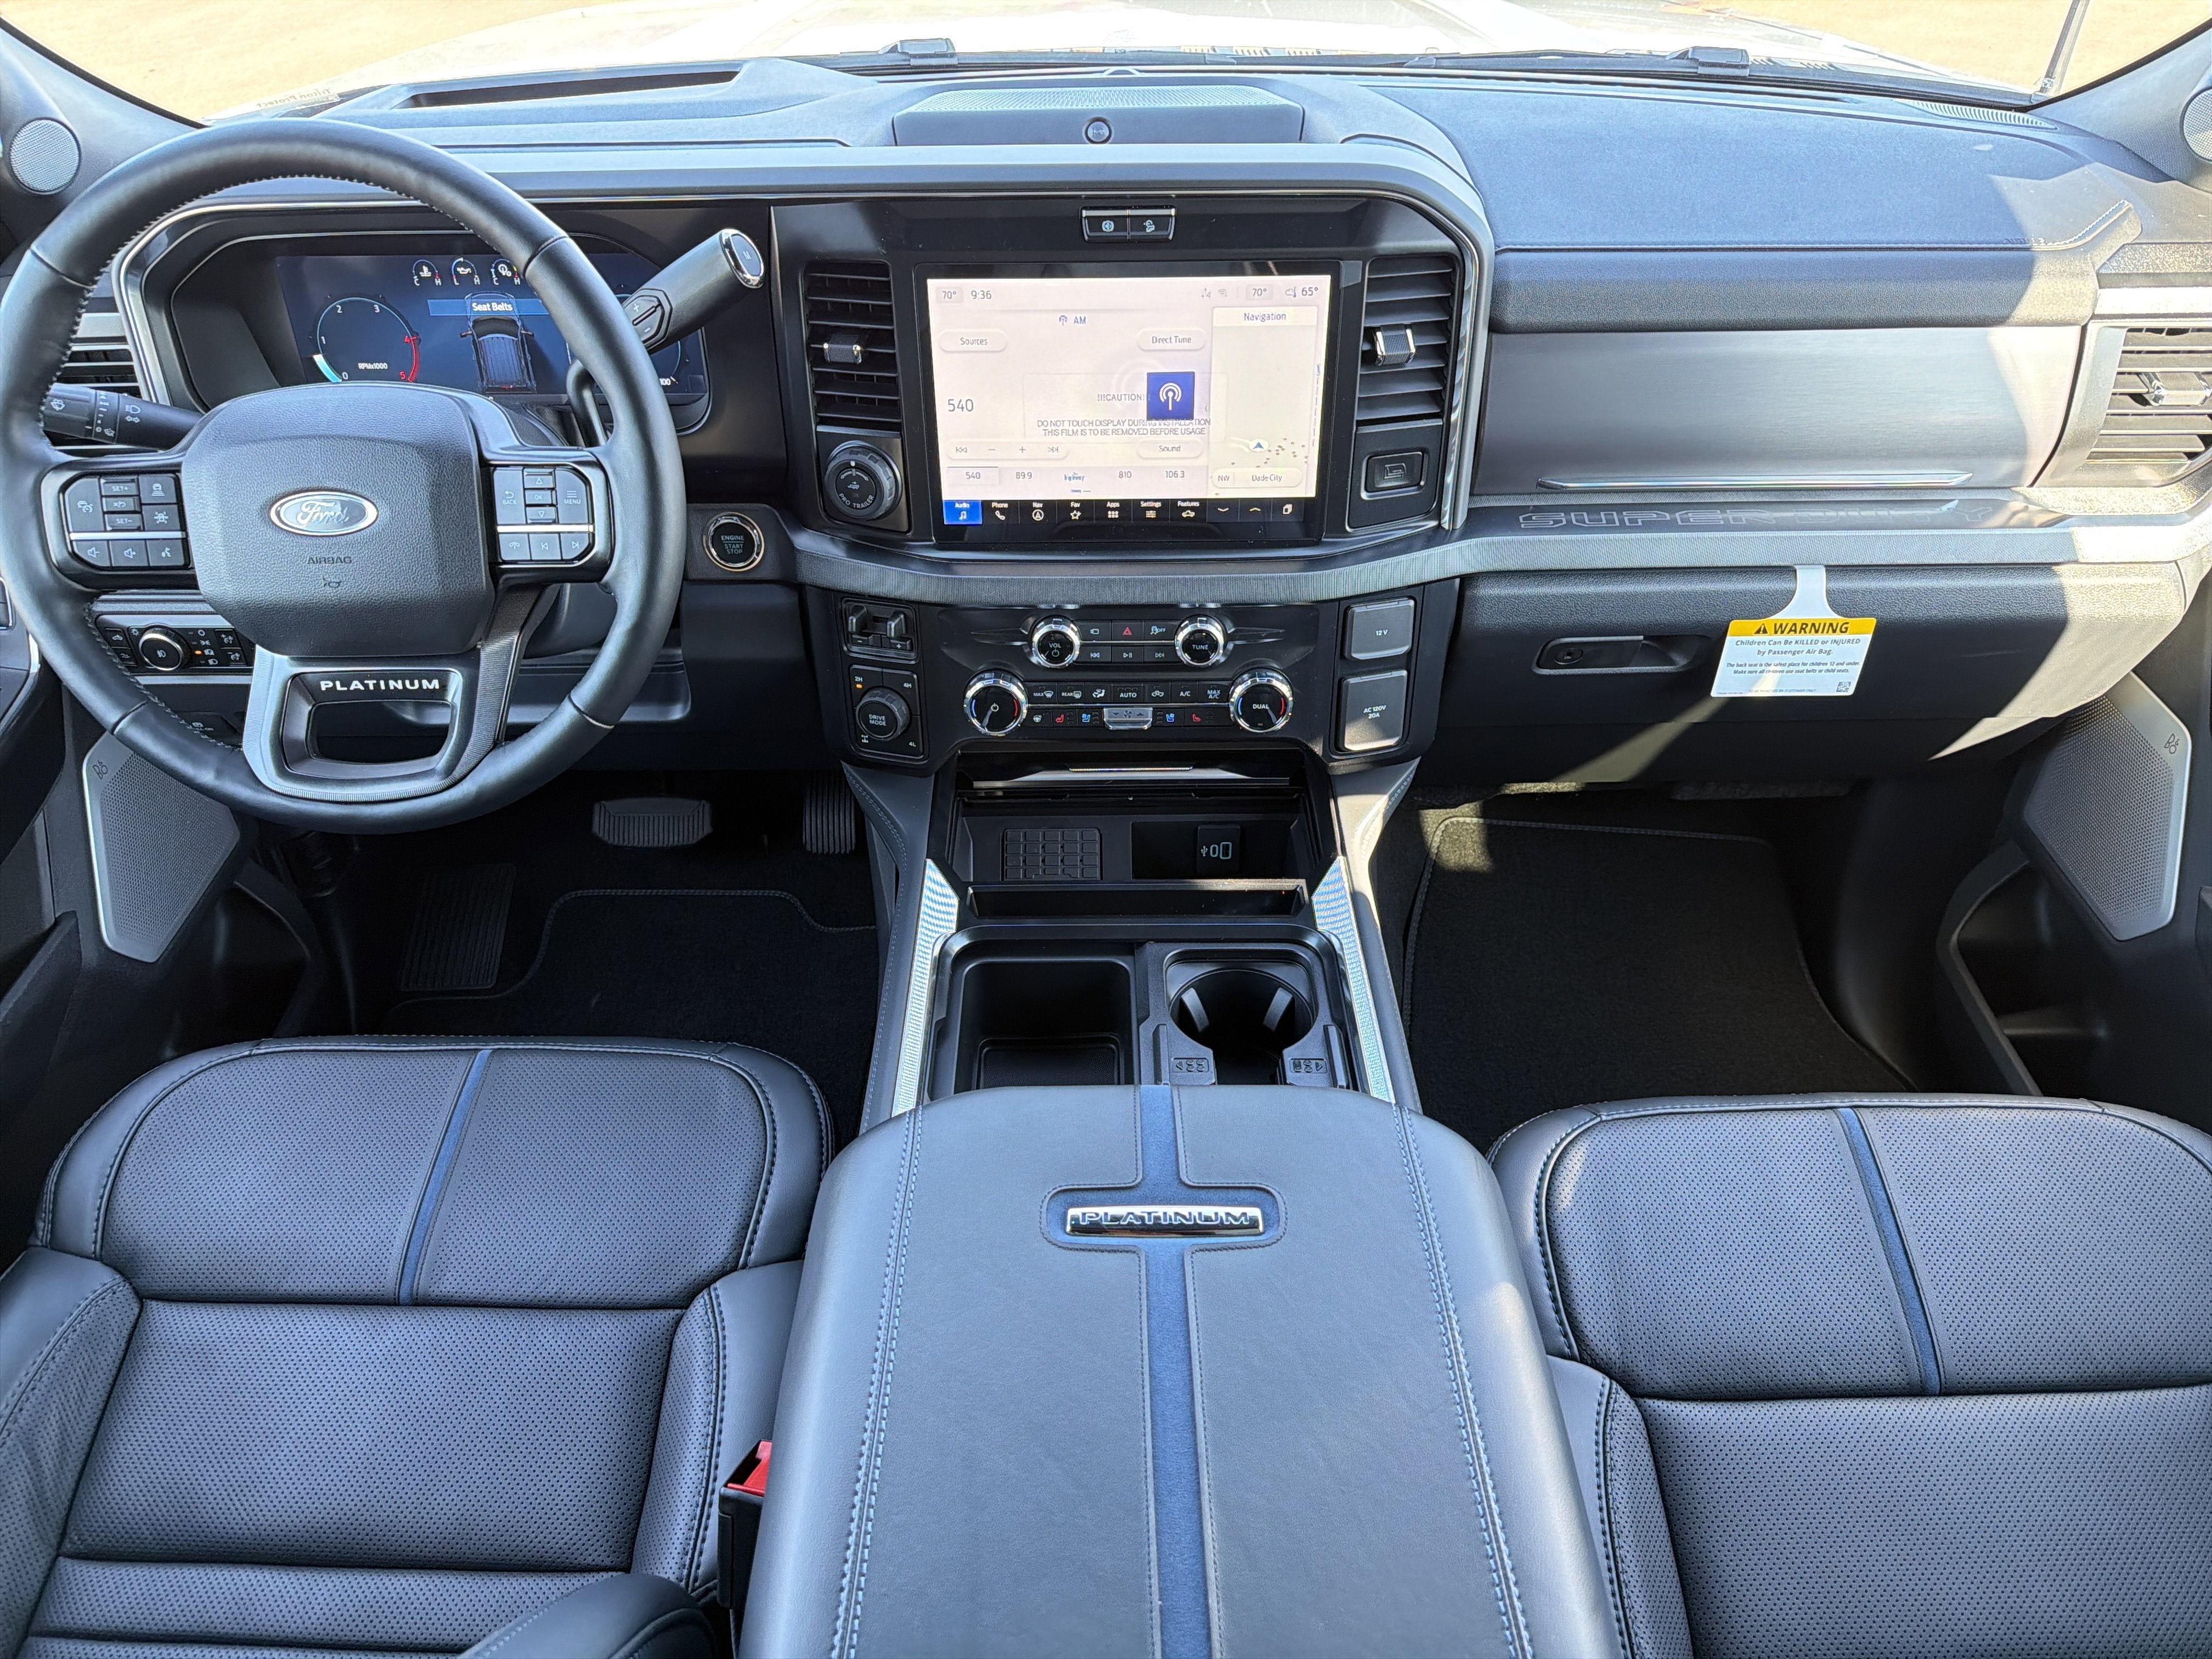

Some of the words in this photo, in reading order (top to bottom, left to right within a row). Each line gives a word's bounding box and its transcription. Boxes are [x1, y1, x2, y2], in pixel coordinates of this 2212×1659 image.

[435, 278, 442, 286] H
[475, 277, 481, 285] H
[970, 290, 992, 300] 9:36
[1301, 287, 1319, 296] 65°
[336, 305, 343, 313] 2
[374, 304, 380, 313] 3
[472, 303, 491, 311] Seat
[493, 303, 513, 311] Belts
[1074, 316, 1086, 324] AM
[1244, 313, 1286, 322] Navigation
[321, 336, 326, 345] 1
[960, 337, 988, 346] Sources
[399, 372, 407, 380] 5
[947, 399, 974, 412] 540
[1269, 475, 1282, 483] City
[839, 493, 850, 506] PRO
[853, 495, 874, 509] TRAILER
[297, 501, 349, 524] Ford
[1519, 509, 1776, 528] SUPER
[1774, 622, 1849, 634] WARNING
[320, 680, 439, 691] PLATINUM
[1080, 1211, 1250, 1224] PLATINUM
